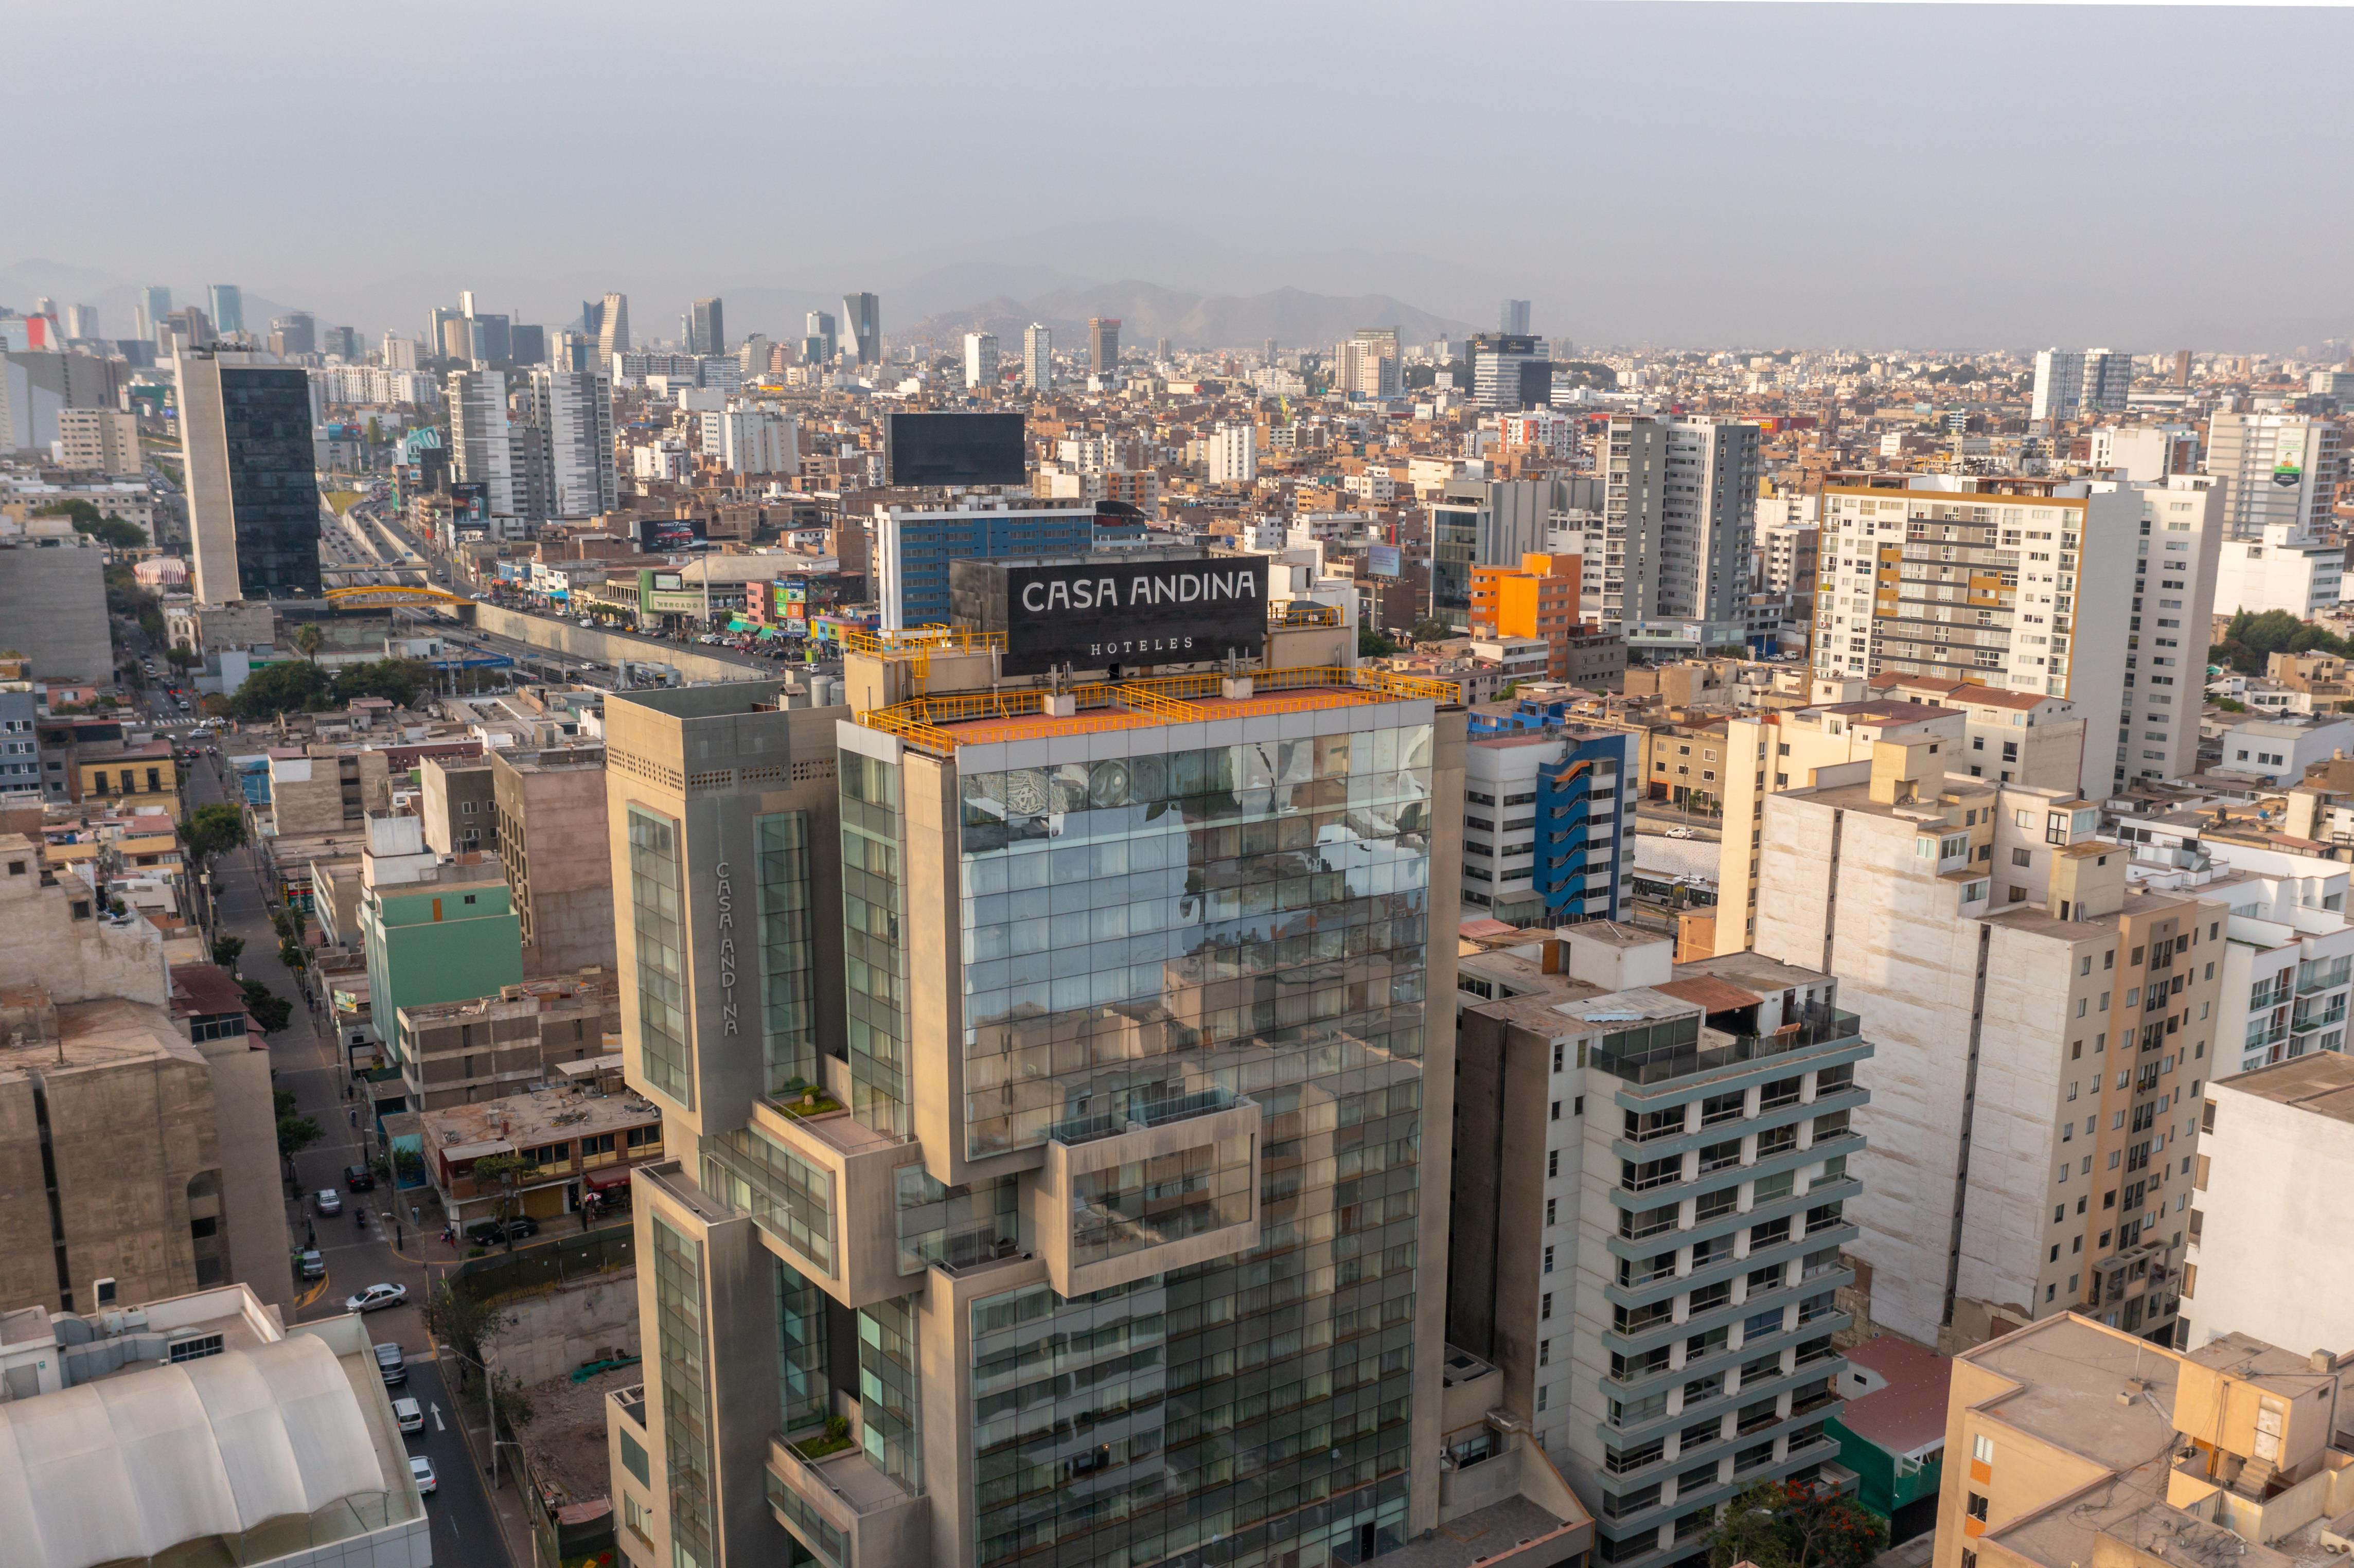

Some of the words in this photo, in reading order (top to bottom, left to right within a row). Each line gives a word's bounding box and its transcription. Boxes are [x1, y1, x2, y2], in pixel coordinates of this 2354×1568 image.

[1022, 578, 1118, 612] CASA
[1130, 571, 1255, 605] ANDINA
[1091, 636, 1193, 655] HOTELES
[716, 862, 733, 930] CASA
[720, 938, 738, 1037] ANDINA
